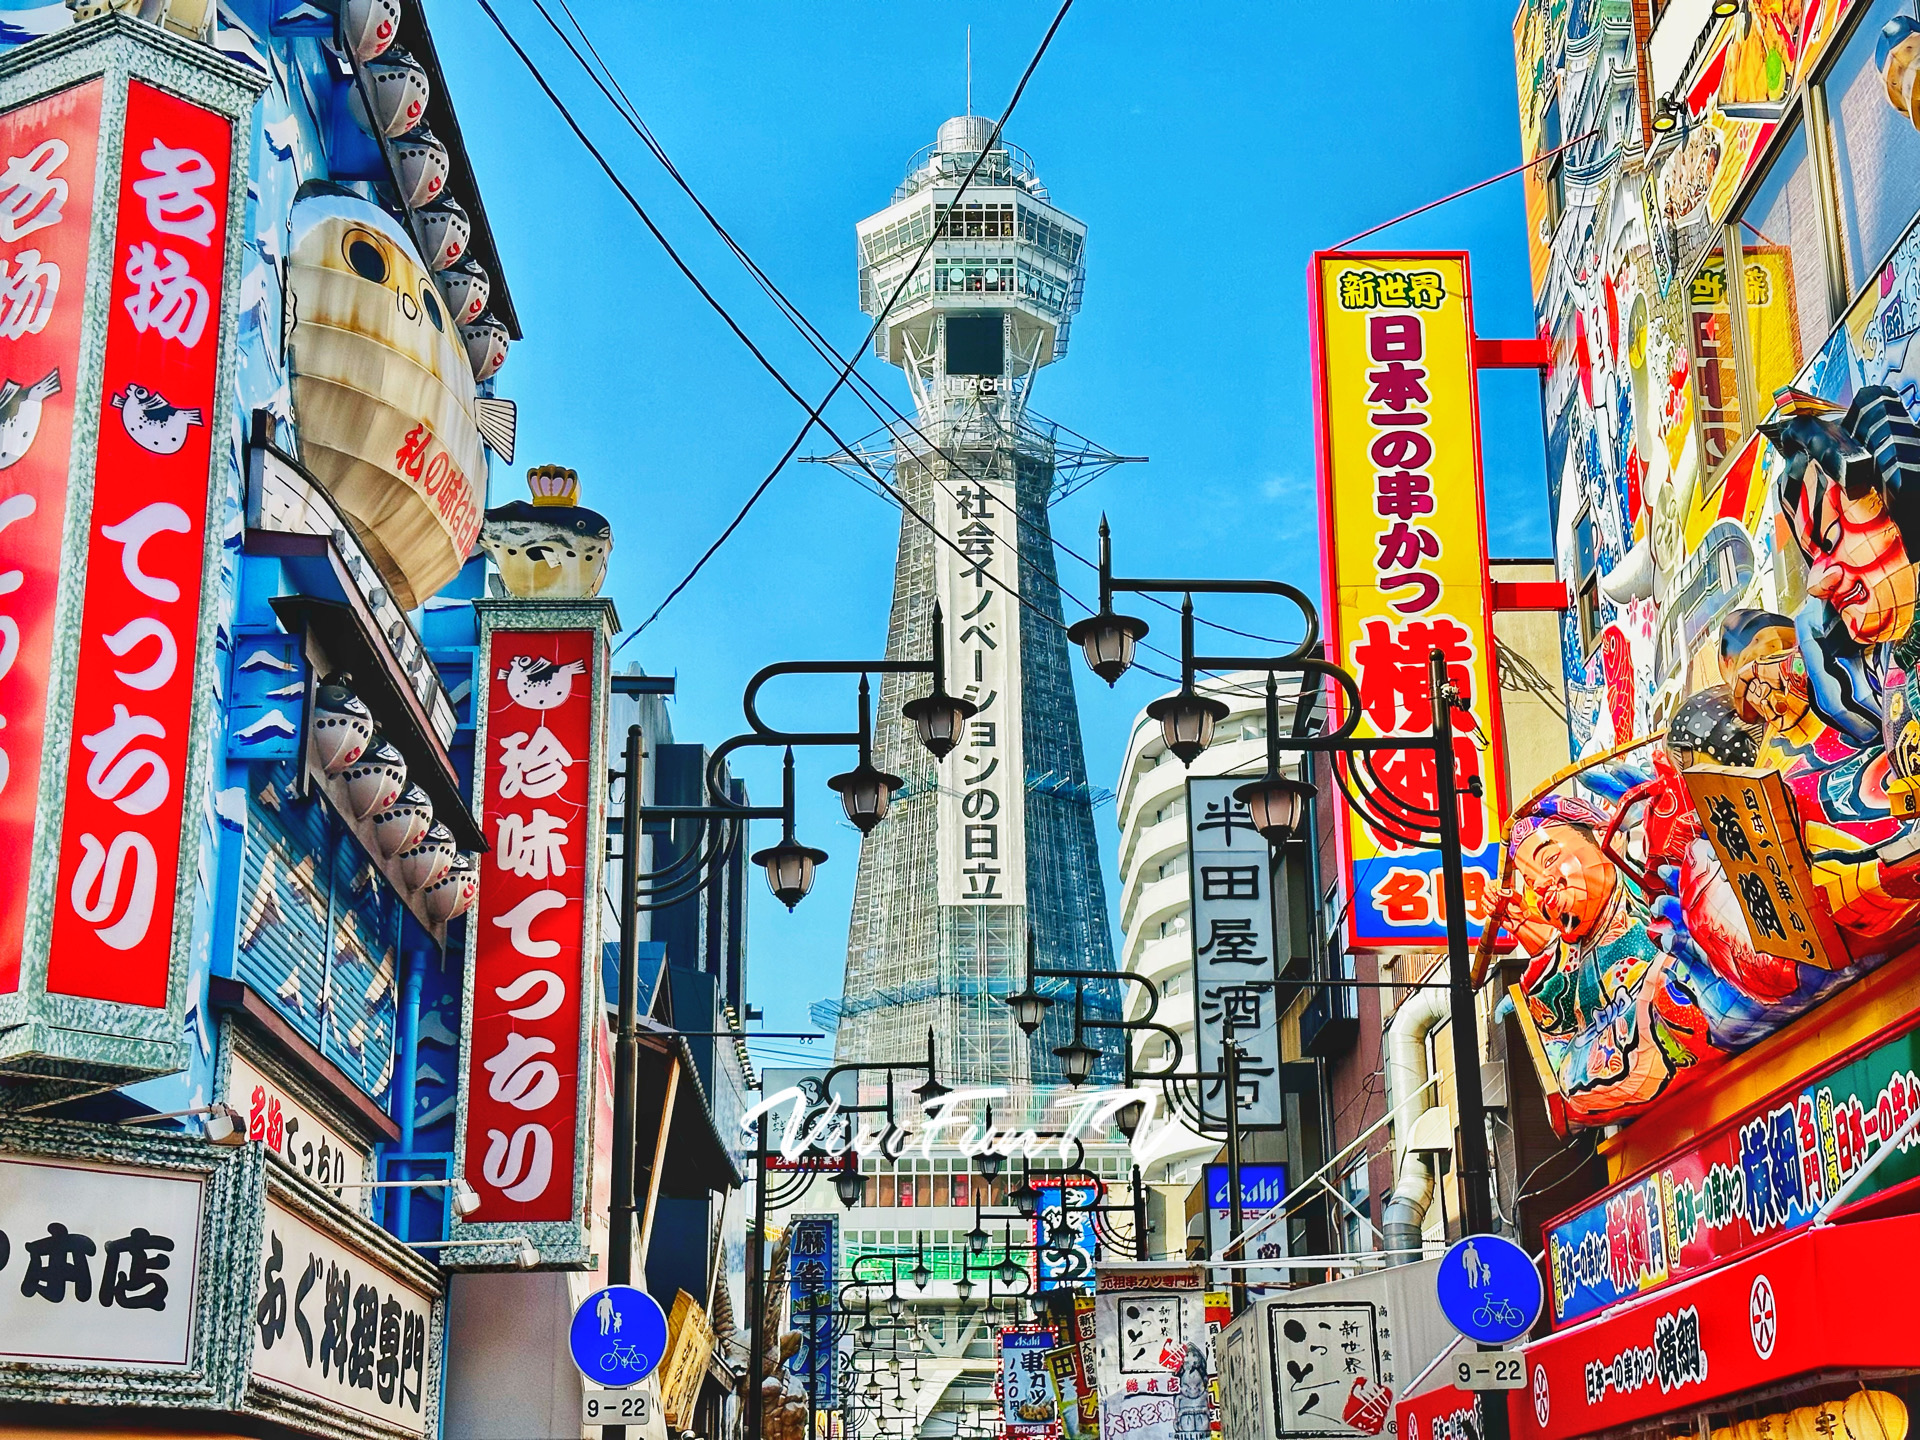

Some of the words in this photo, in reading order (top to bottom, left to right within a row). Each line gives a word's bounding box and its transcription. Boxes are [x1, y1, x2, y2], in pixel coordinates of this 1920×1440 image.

[1339, 271, 1445, 309] 新世界
[938, 378, 1013, 391] HITACHI
[1367, 315, 1441, 613] 日本一の串かつ
[71, 501, 192, 950] てっちり
[955, 485, 1004, 899] 社会イノベーションの日立
[1704, 793, 1789, 941] 横綱
[1741, 787, 1816, 961] 日本一の串かつ
[482, 726, 573, 1203] 珍味てっちり
[1197, 795, 1275, 1104] 半田屋酒店
[1215, 1178, 1279, 1203] Asahi
[1219, 1210, 1277, 1221] アヒビール
[1674, 1165, 1744, 1245] 日本一の串かつ
[1741, 1109, 1800, 1232] 横綱
[1799, 1100, 1824, 1204] 名門
[0, 1222, 175, 1312] 本店
[793, 1223, 827, 1291] 麻雀
[1101, 1275, 1200, 1289] 元祖串カツ専門店
[1559, 1232, 1609, 1299] 日本一の串かつ
[1647, 1184, 1665, 1273] 名門
[257, 1229, 426, 1414] ふぐ料理専門
[791, 1290, 832, 1314] NEW
[1015, 1336, 1040, 1347] Asahi
[1378, 1305, 1395, 1383] 商標登録
[1020, 1350, 1048, 1405] 串カツ
[1283, 1319, 1342, 1425] いっとく
[1339, 1320, 1366, 1375] 新世界
[1586, 1349, 1654, 1401] 日本一の串かつ
[1656, 1310, 1701, 1389] 横綱
[1105, 1400, 1177, 1437] 大阪名物
